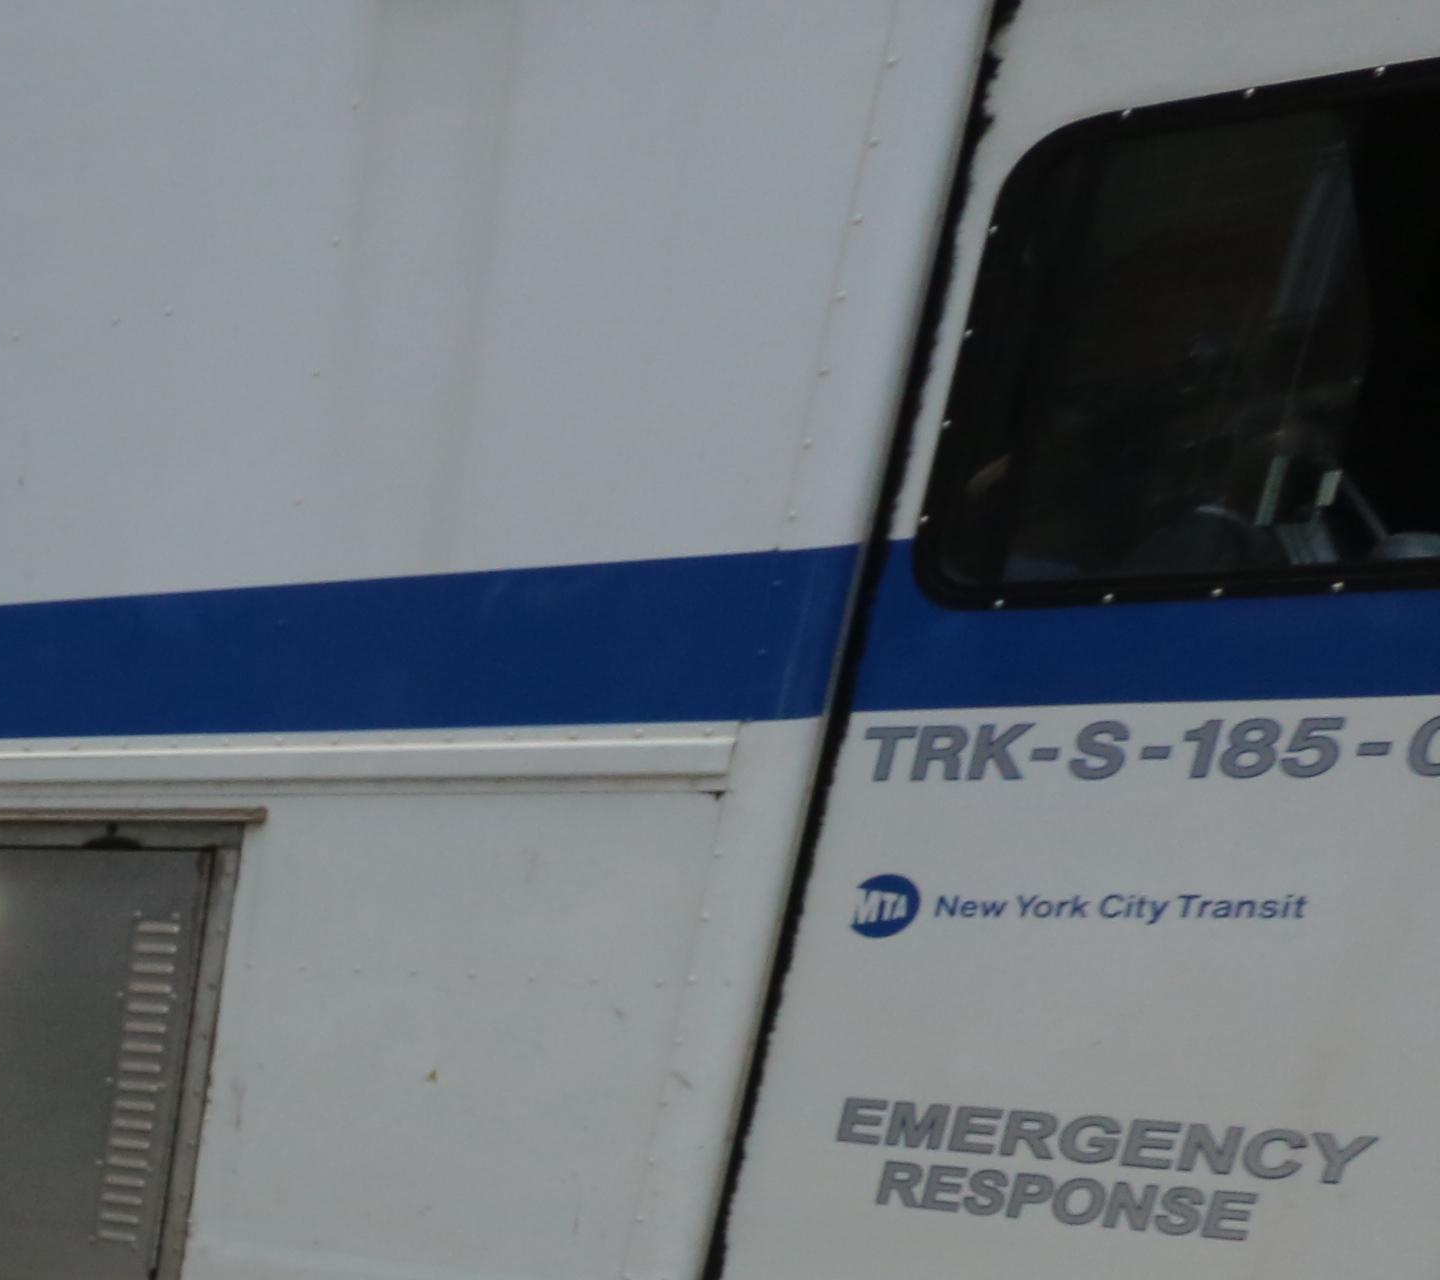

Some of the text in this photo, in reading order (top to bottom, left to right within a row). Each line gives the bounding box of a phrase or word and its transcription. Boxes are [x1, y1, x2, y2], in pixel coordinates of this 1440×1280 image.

[852, 886, 913, 929] MTA
[933, 894, 1308, 925] New York City Transit
[836, 1097, 1379, 1184] EMERGENCY
[875, 1160, 1259, 1241] RESPONSE
